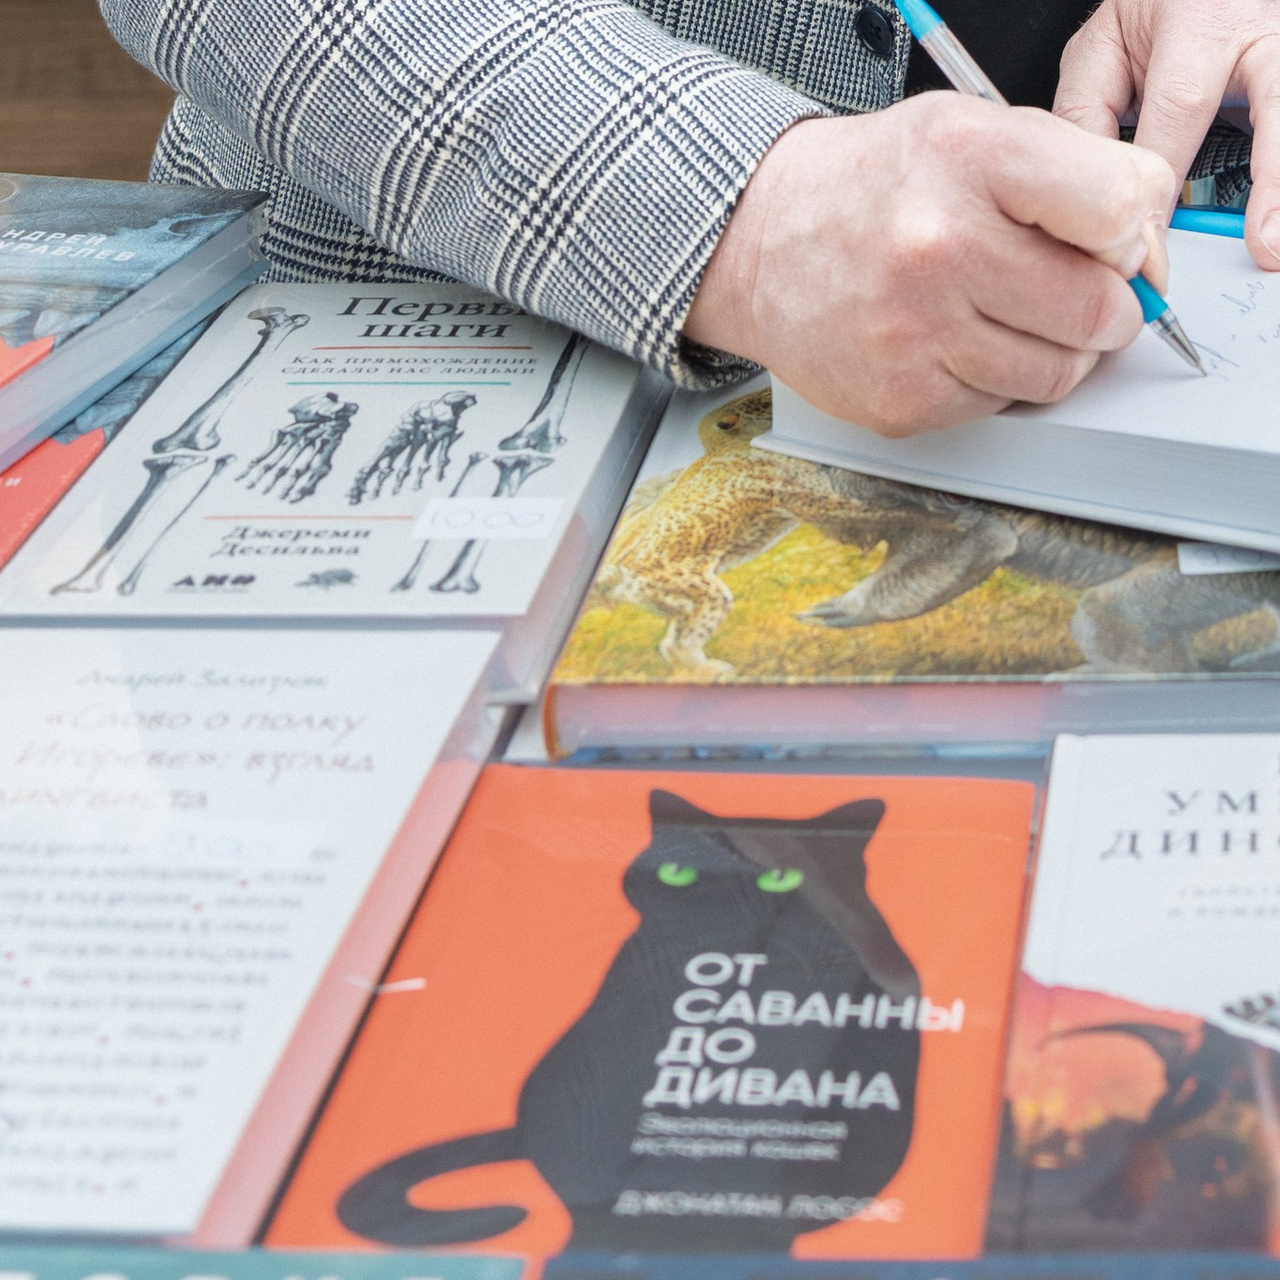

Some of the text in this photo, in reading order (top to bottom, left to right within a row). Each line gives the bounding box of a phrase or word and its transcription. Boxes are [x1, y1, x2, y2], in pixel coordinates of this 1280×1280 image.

[1, 229, 107, 246] НДРЕЙ
[0, 241, 135, 261] УРАВЛЕВ
[336, 296, 530, 322] Первы
[357, 324, 512, 338] шаги
[222, 526, 373, 541] Джереми
[210, 542, 360, 558] Десильва
[683, 951, 768, 986] ОТ
[672, 988, 965, 1032] САВАННЫ
[653, 1025, 757, 1067] ДО
[641, 1066, 901, 1110] ДИВАНА
